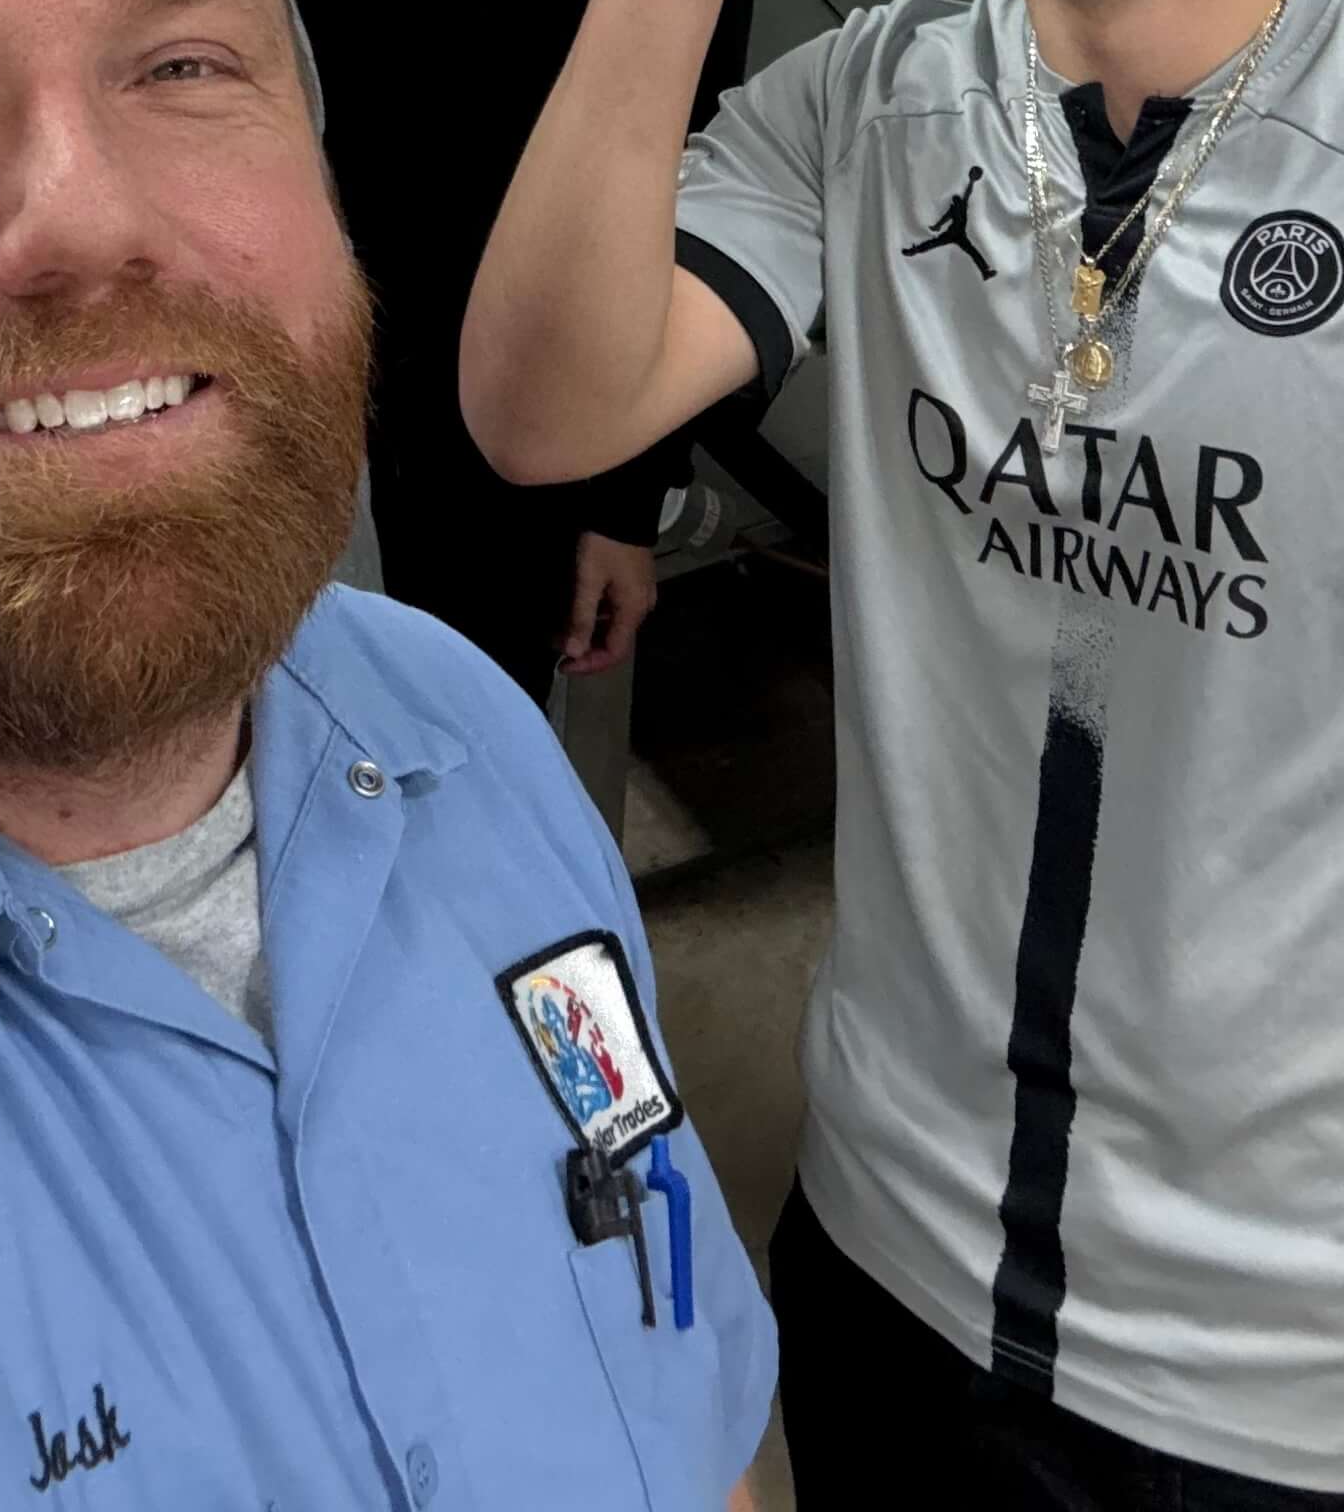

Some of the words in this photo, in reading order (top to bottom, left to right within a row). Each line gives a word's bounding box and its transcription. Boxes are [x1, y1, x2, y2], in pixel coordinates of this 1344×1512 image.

[1256, 225, 1330, 255] PARIS
[908, 387, 1269, 563] QATAR
[977, 517, 1269, 639] AIRWAYS
